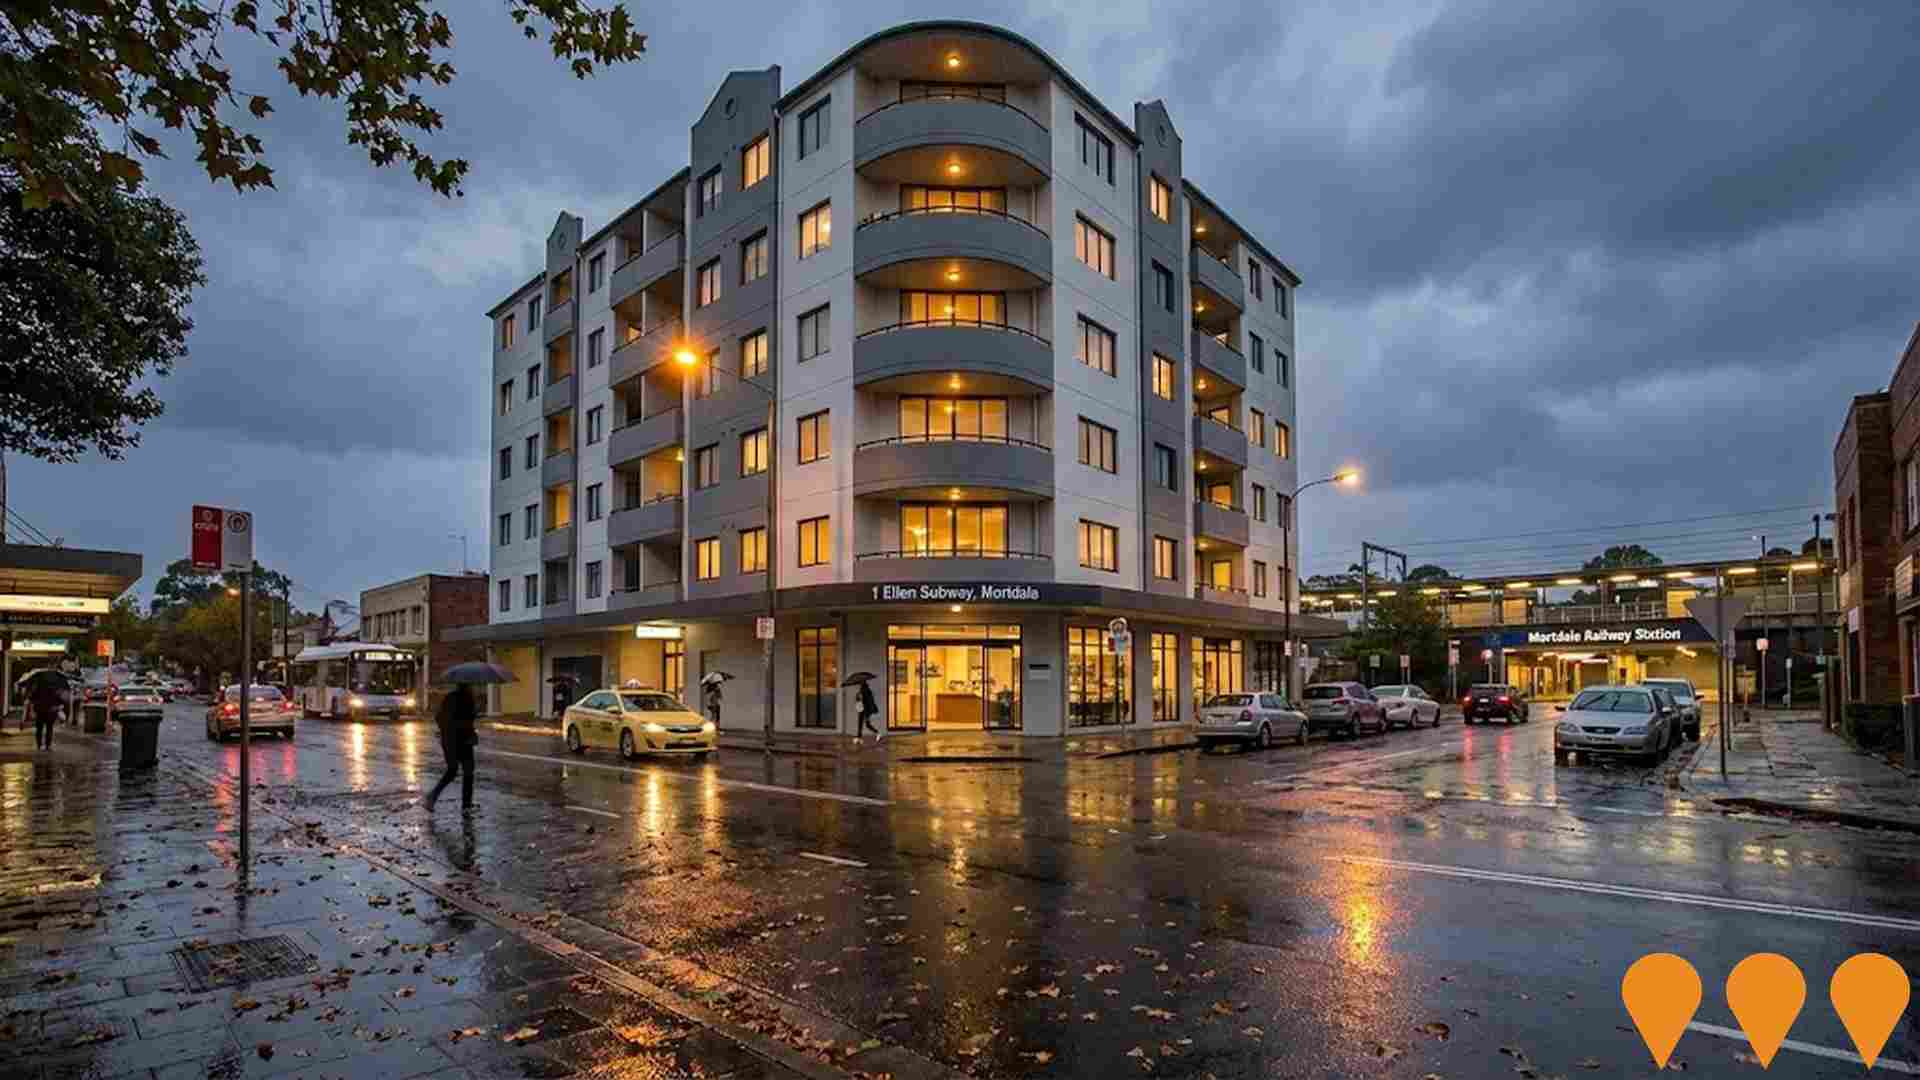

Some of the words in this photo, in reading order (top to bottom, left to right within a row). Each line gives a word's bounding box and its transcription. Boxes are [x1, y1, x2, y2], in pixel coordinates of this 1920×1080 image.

[872, 586, 878, 600] 1
[883, 585, 917, 600] Ellen
[920, 585, 977, 602] Subway,
[1528, 630, 1581, 643] Mortdale
[1584, 629, 1632, 644] Railway
